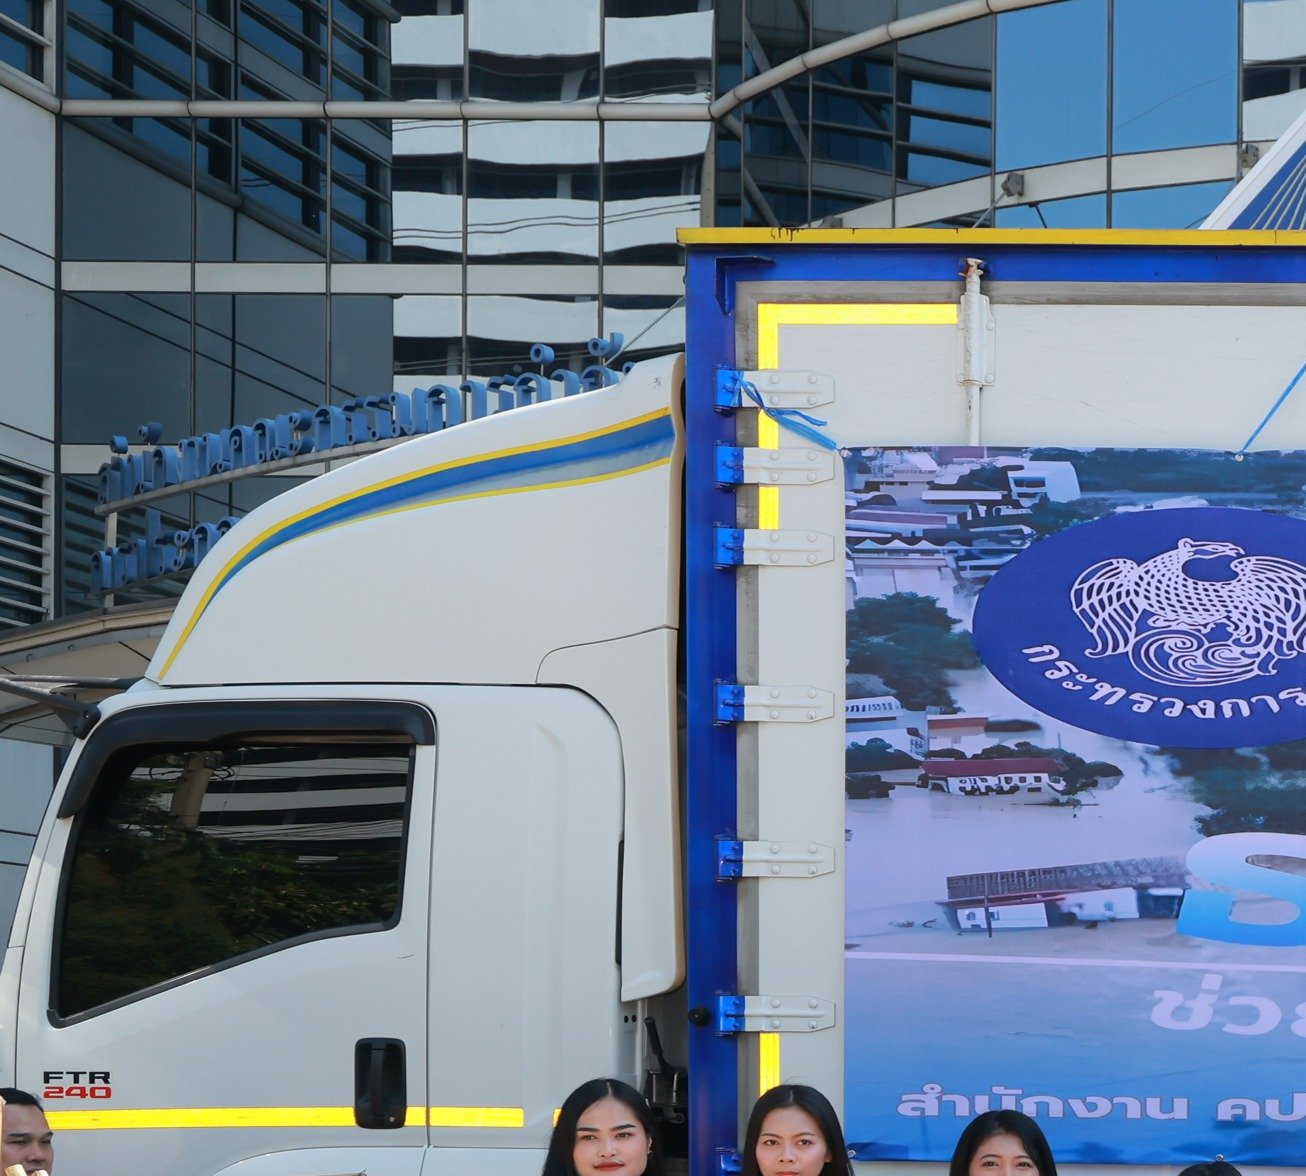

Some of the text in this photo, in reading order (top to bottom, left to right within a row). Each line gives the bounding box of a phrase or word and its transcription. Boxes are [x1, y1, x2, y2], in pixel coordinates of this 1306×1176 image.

[43, 1071, 112, 1085] FTR
[43, 1086, 112, 1100] 240
[897, 1082, 1188, 1121] สำนักงาน
